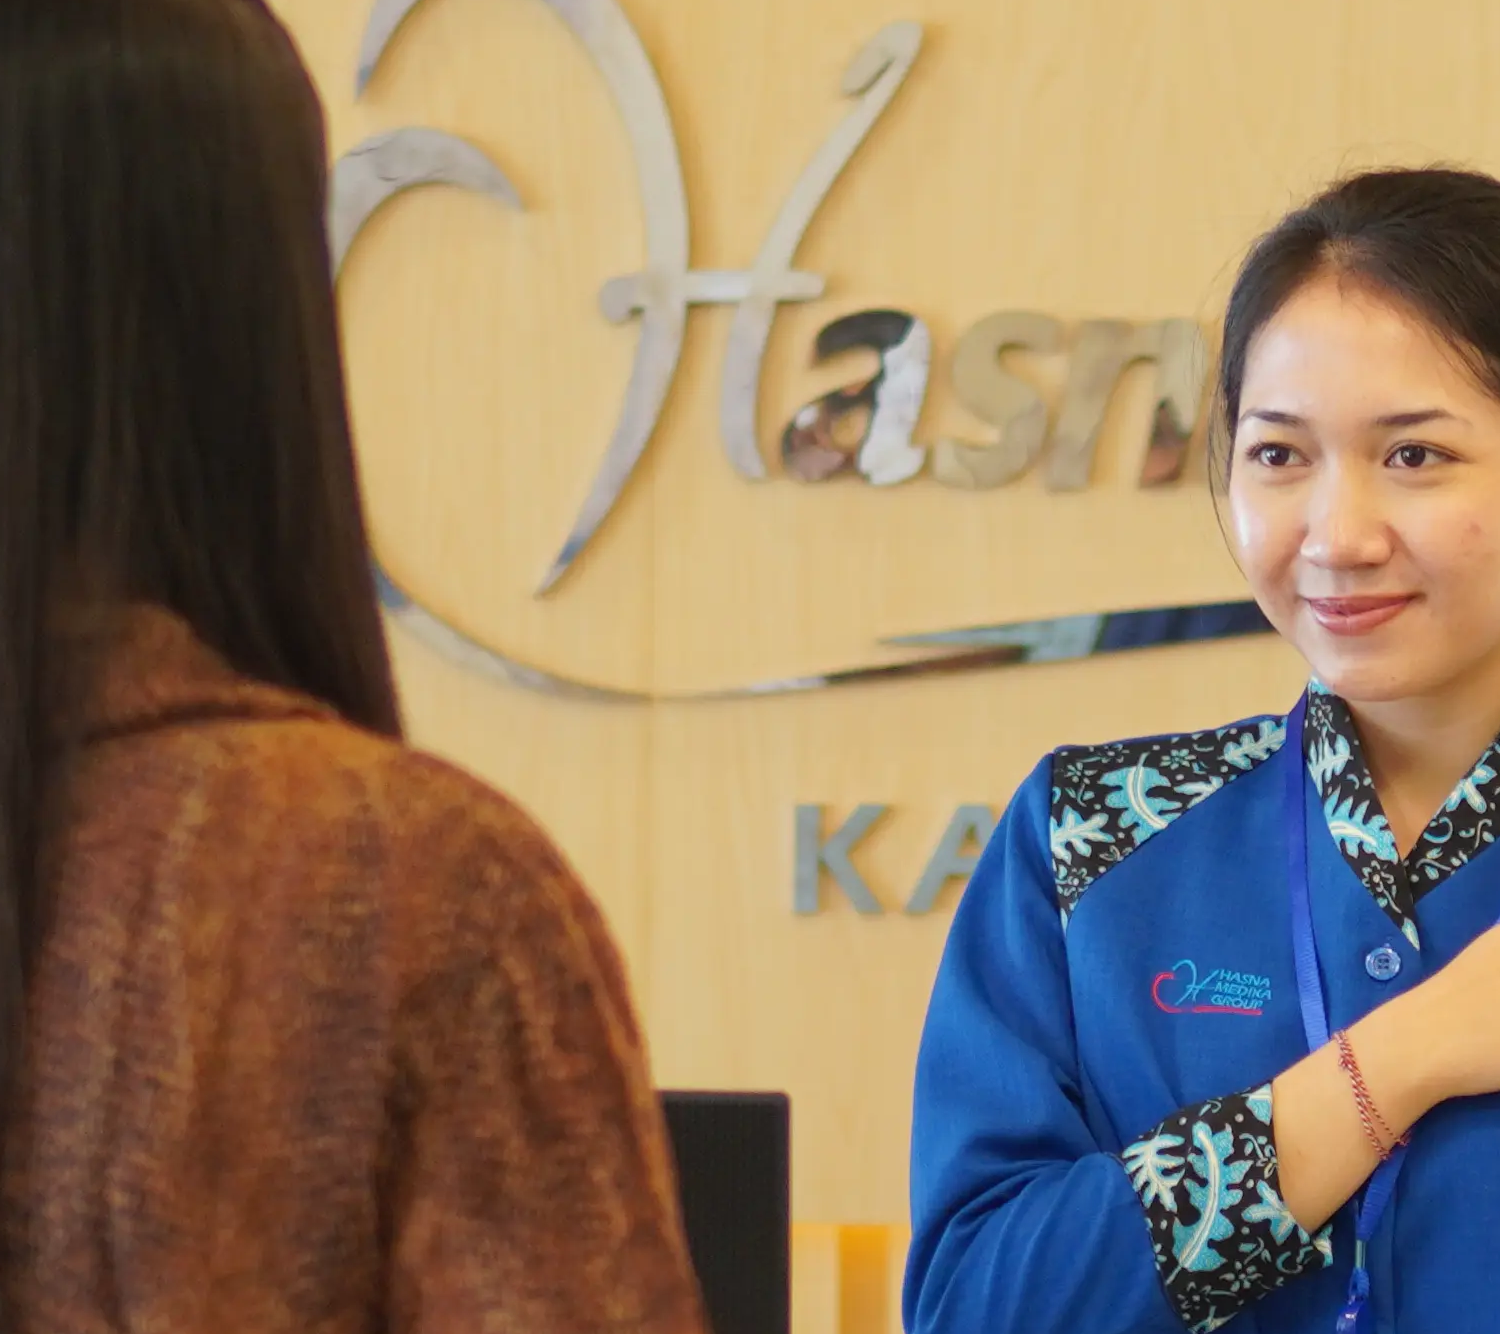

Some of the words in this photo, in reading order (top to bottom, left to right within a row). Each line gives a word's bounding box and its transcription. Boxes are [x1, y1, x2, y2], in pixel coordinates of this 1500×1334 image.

[1219, 969, 1271, 988] HASNA
[1214, 981, 1272, 1000] MEDIKA
[1211, 994, 1264, 1009] GROUP
